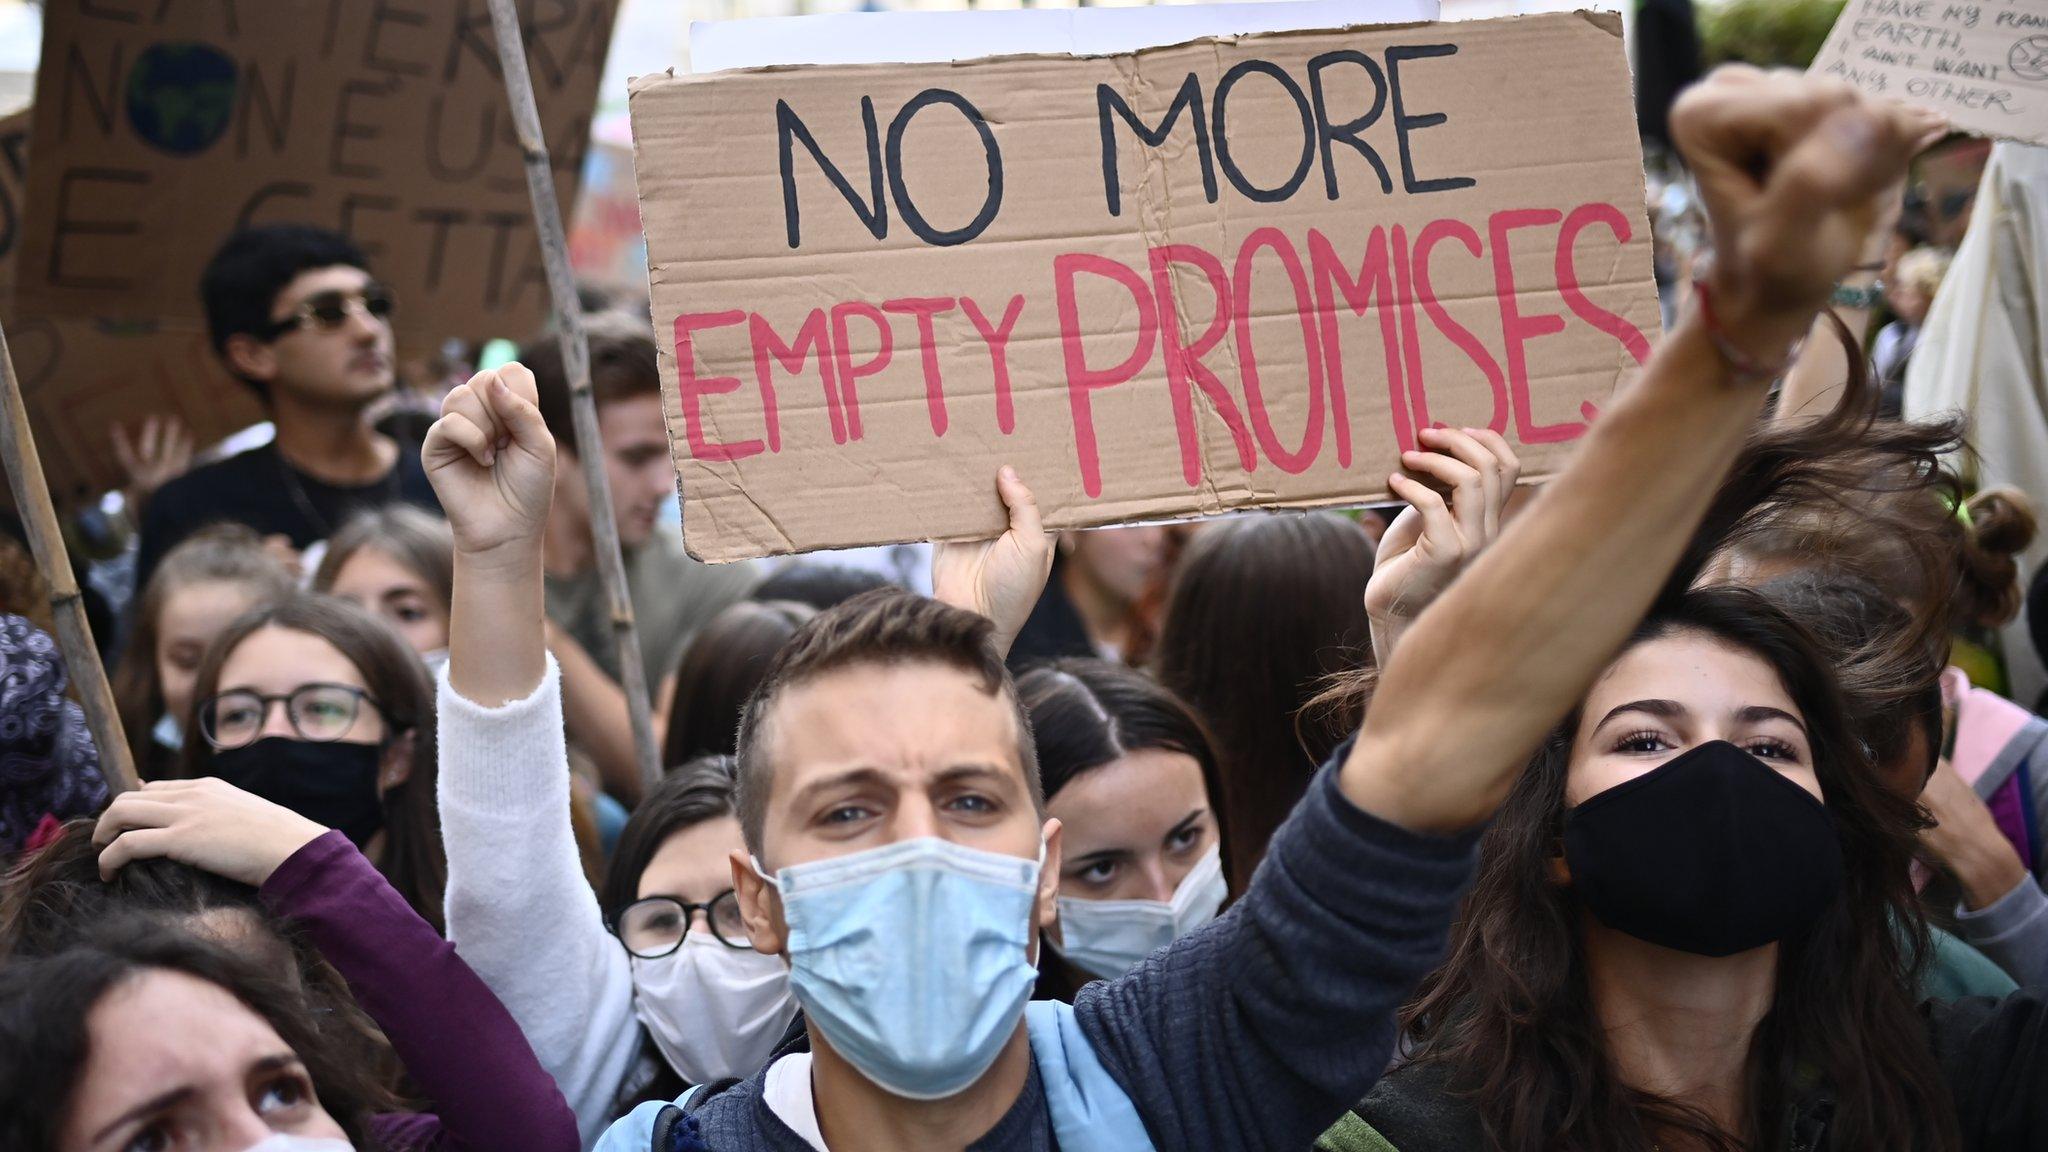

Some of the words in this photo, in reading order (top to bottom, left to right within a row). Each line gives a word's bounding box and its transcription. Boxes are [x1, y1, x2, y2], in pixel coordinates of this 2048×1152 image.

[1905, 77, 2026, 115] OTHER
[1932, 56, 2004, 80] WANT
[776, 88, 1004, 249] NO
[1096, 43, 1477, 217] MORE
[674, 293, 1026, 462] EMPTY
[1053, 202, 1652, 499] PROMISES
